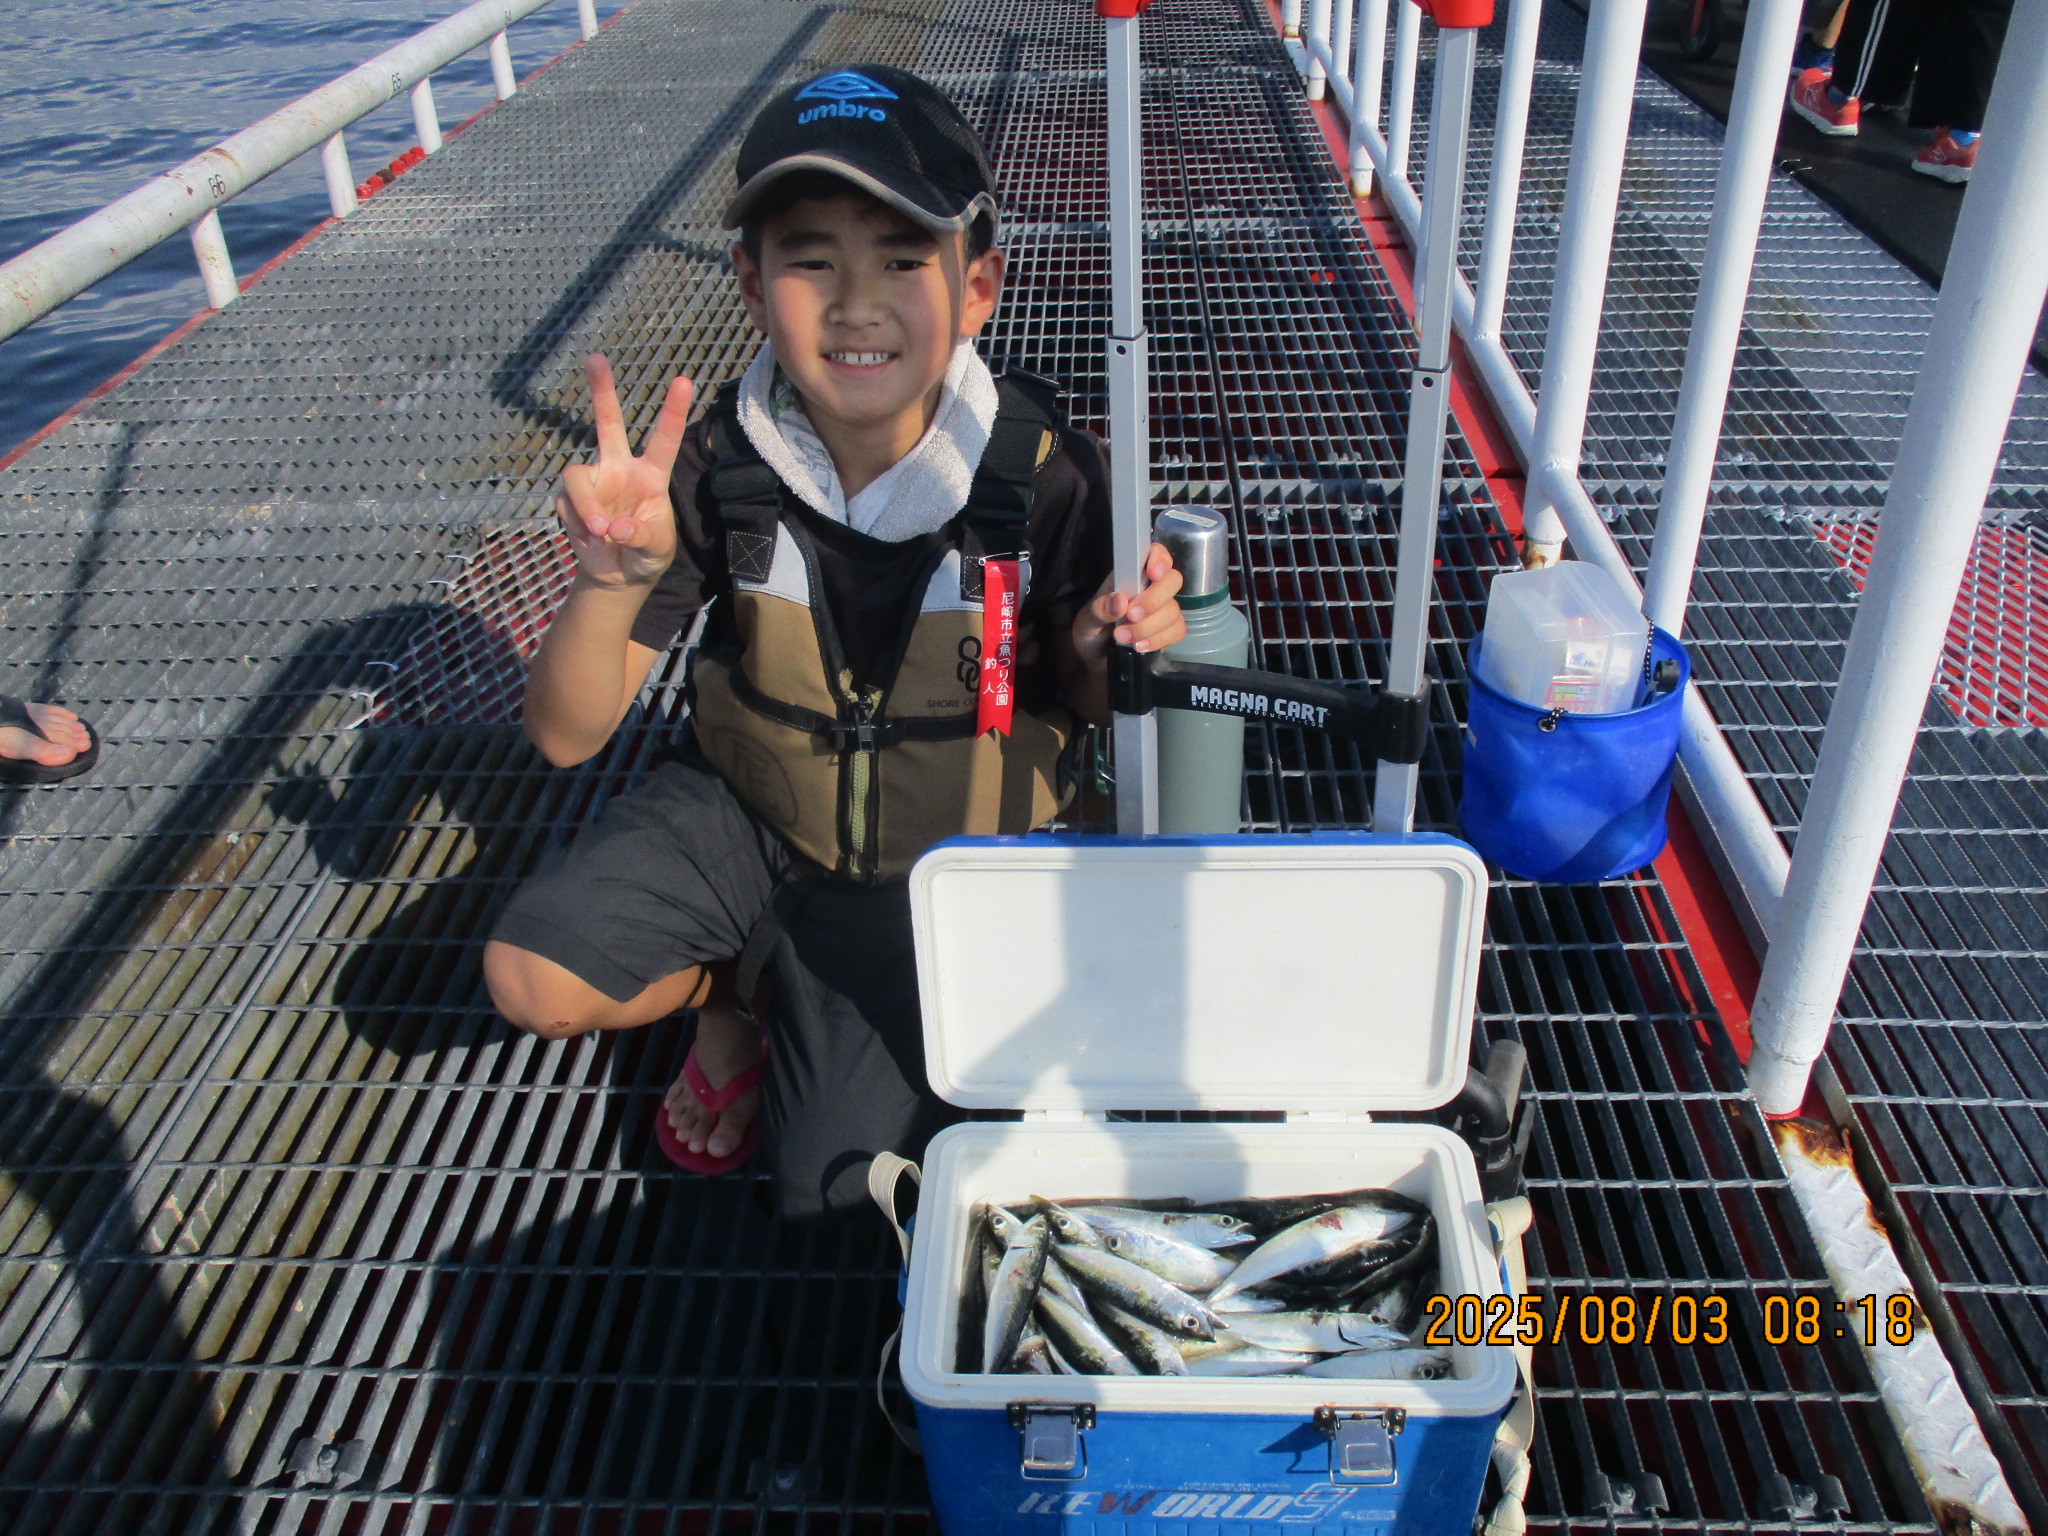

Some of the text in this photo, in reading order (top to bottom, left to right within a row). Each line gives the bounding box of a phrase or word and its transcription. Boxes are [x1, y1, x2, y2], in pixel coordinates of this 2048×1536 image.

[797, 100, 887, 125] umbro
[208, 173, 227, 198] 66
[926, 700, 960, 708] SHORE
[1191, 685, 1329, 725] MAGNA CART
